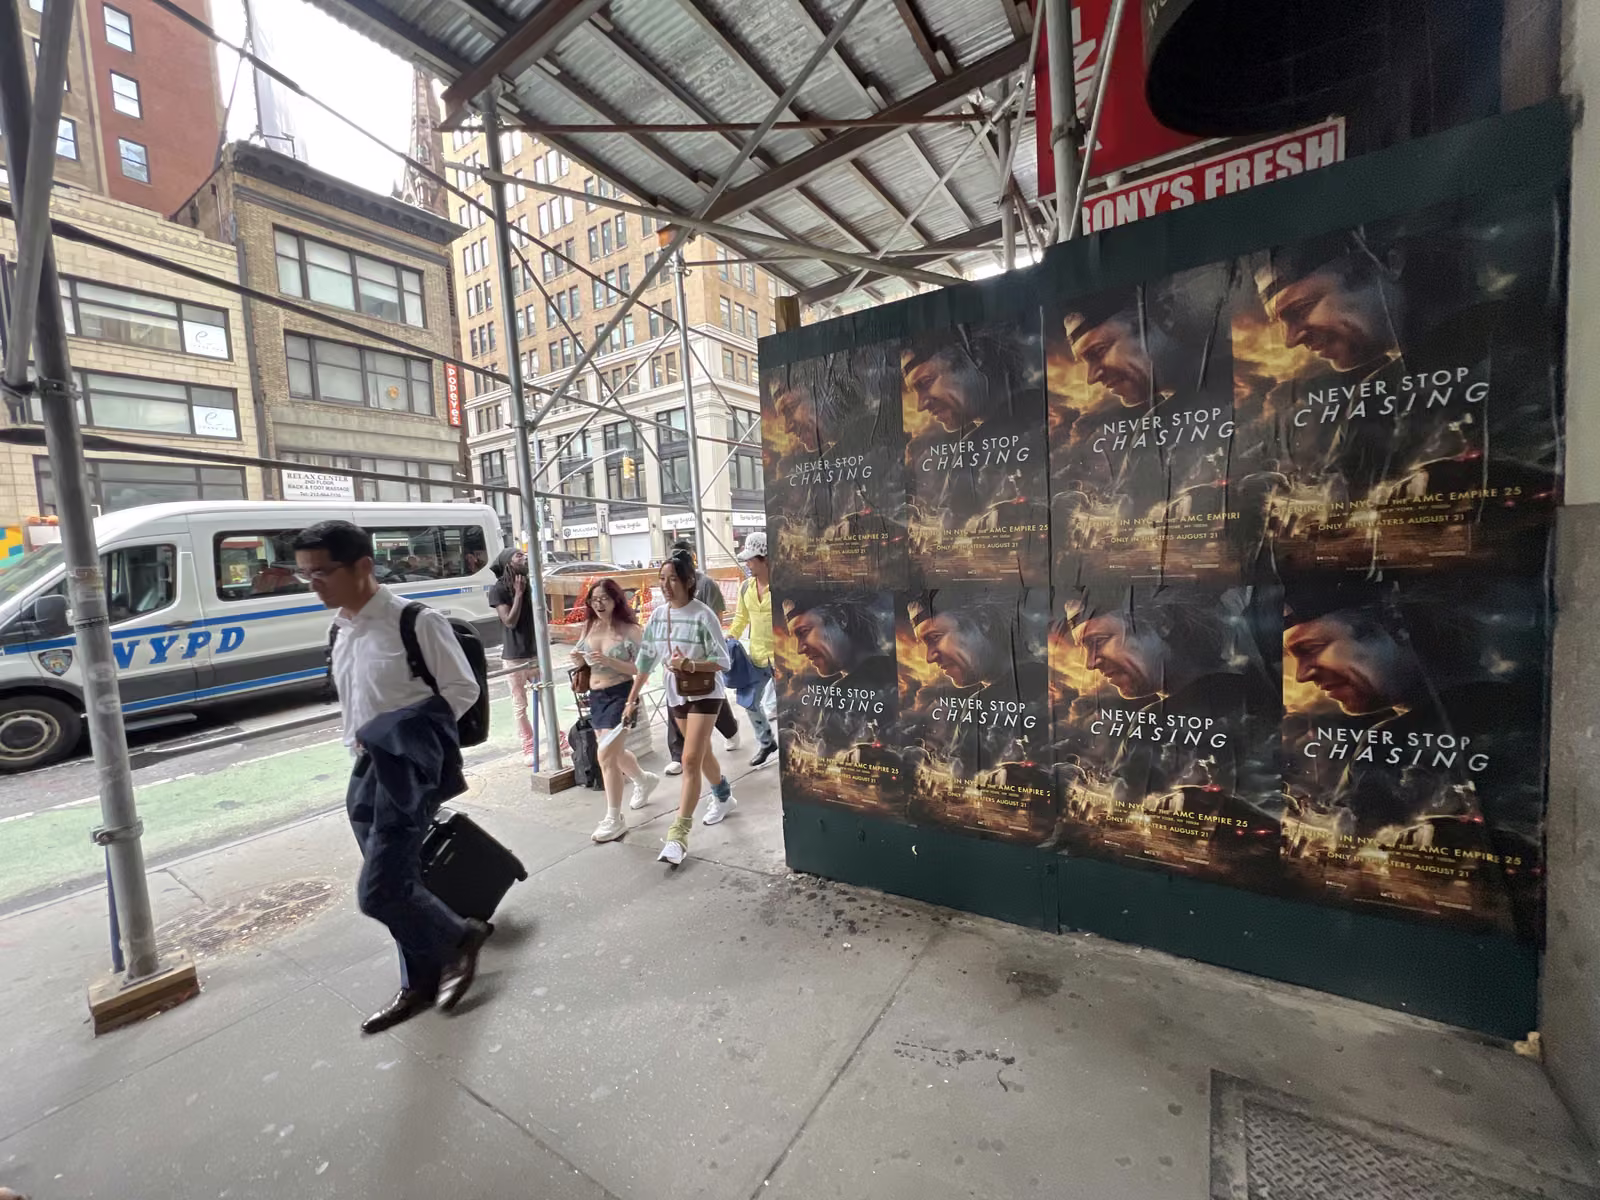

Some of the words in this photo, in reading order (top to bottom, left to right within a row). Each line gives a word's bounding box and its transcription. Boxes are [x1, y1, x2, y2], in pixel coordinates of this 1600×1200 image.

[1204, 130, 1335, 201] FRESH
[1309, 380, 1387, 406] NEVER
[1402, 367, 1469, 391] STOP
[1294, 382, 1489, 427] CHASING
[1104, 416, 1162, 435] NEVER
[1172, 408, 1221, 426] STOP
[930, 441, 974, 456] NEVER
[982, 435, 1019, 450] STOP
[1093, 421, 1234, 453] CHASING
[795, 460, 830, 473] NEVER
[835, 455, 864, 468] STOP
[922, 448, 1030, 472] CHASING
[318, 474, 348, 482] CENTER
[789, 466, 872, 487] CHASING
[1331, 502, 1344, 510] IN
[1412, 492, 1443, 503] AMC
[1450, 488, 1497, 500] EMPIRE
[1504, 486, 1522, 496] 25
[1180, 514, 1203, 522] AMC
[1318, 522, 1342, 531] ONLY
[1407, 514, 1448, 525] AUGUST
[1454, 514, 1464, 522] 21
[112, 626, 246, 670] NYPD
[808, 685, 842, 697] NEVER
[847, 688, 876, 700] STOP
[801, 695, 884, 714] CHASING
[940, 697, 983, 710] NEVER
[990, 700, 1026, 713] STOP
[932, 708, 1037, 729] CHASING
[1101, 708, 1157, 725] NEVER
[1167, 714, 1213, 730] STOP
[1091, 721, 1227, 748] CHASING
[1317, 727, 1393, 745] NEVER
[1408, 732, 1470, 750] STOP
[1304, 742, 1490, 772] CHASING
[869, 764, 889, 772] EMPIRE
[999, 784, 1015, 792] AMC
[1018, 787, 1044, 796] EMPIRE
[997, 799, 1019, 807] AUGUST
[1106, 816, 1123, 824] ONLY
[1170, 826, 1198, 836] AUGUST
[1172, 810, 1194, 820] AMC
[1198, 814, 1232, 825] EMPIRE
[1236, 820, 1248, 828] 25
[1339, 834, 1353, 842] IN
[1418, 845, 1449, 856] AMC
[1455, 848, 1499, 864] EMPIRE
[1505, 856, 1521, 866] 25
[1327, 851, 1351, 862] ONLY
[1415, 864, 1455, 876] AUGUST
[1458, 870, 1469, 878] 21
